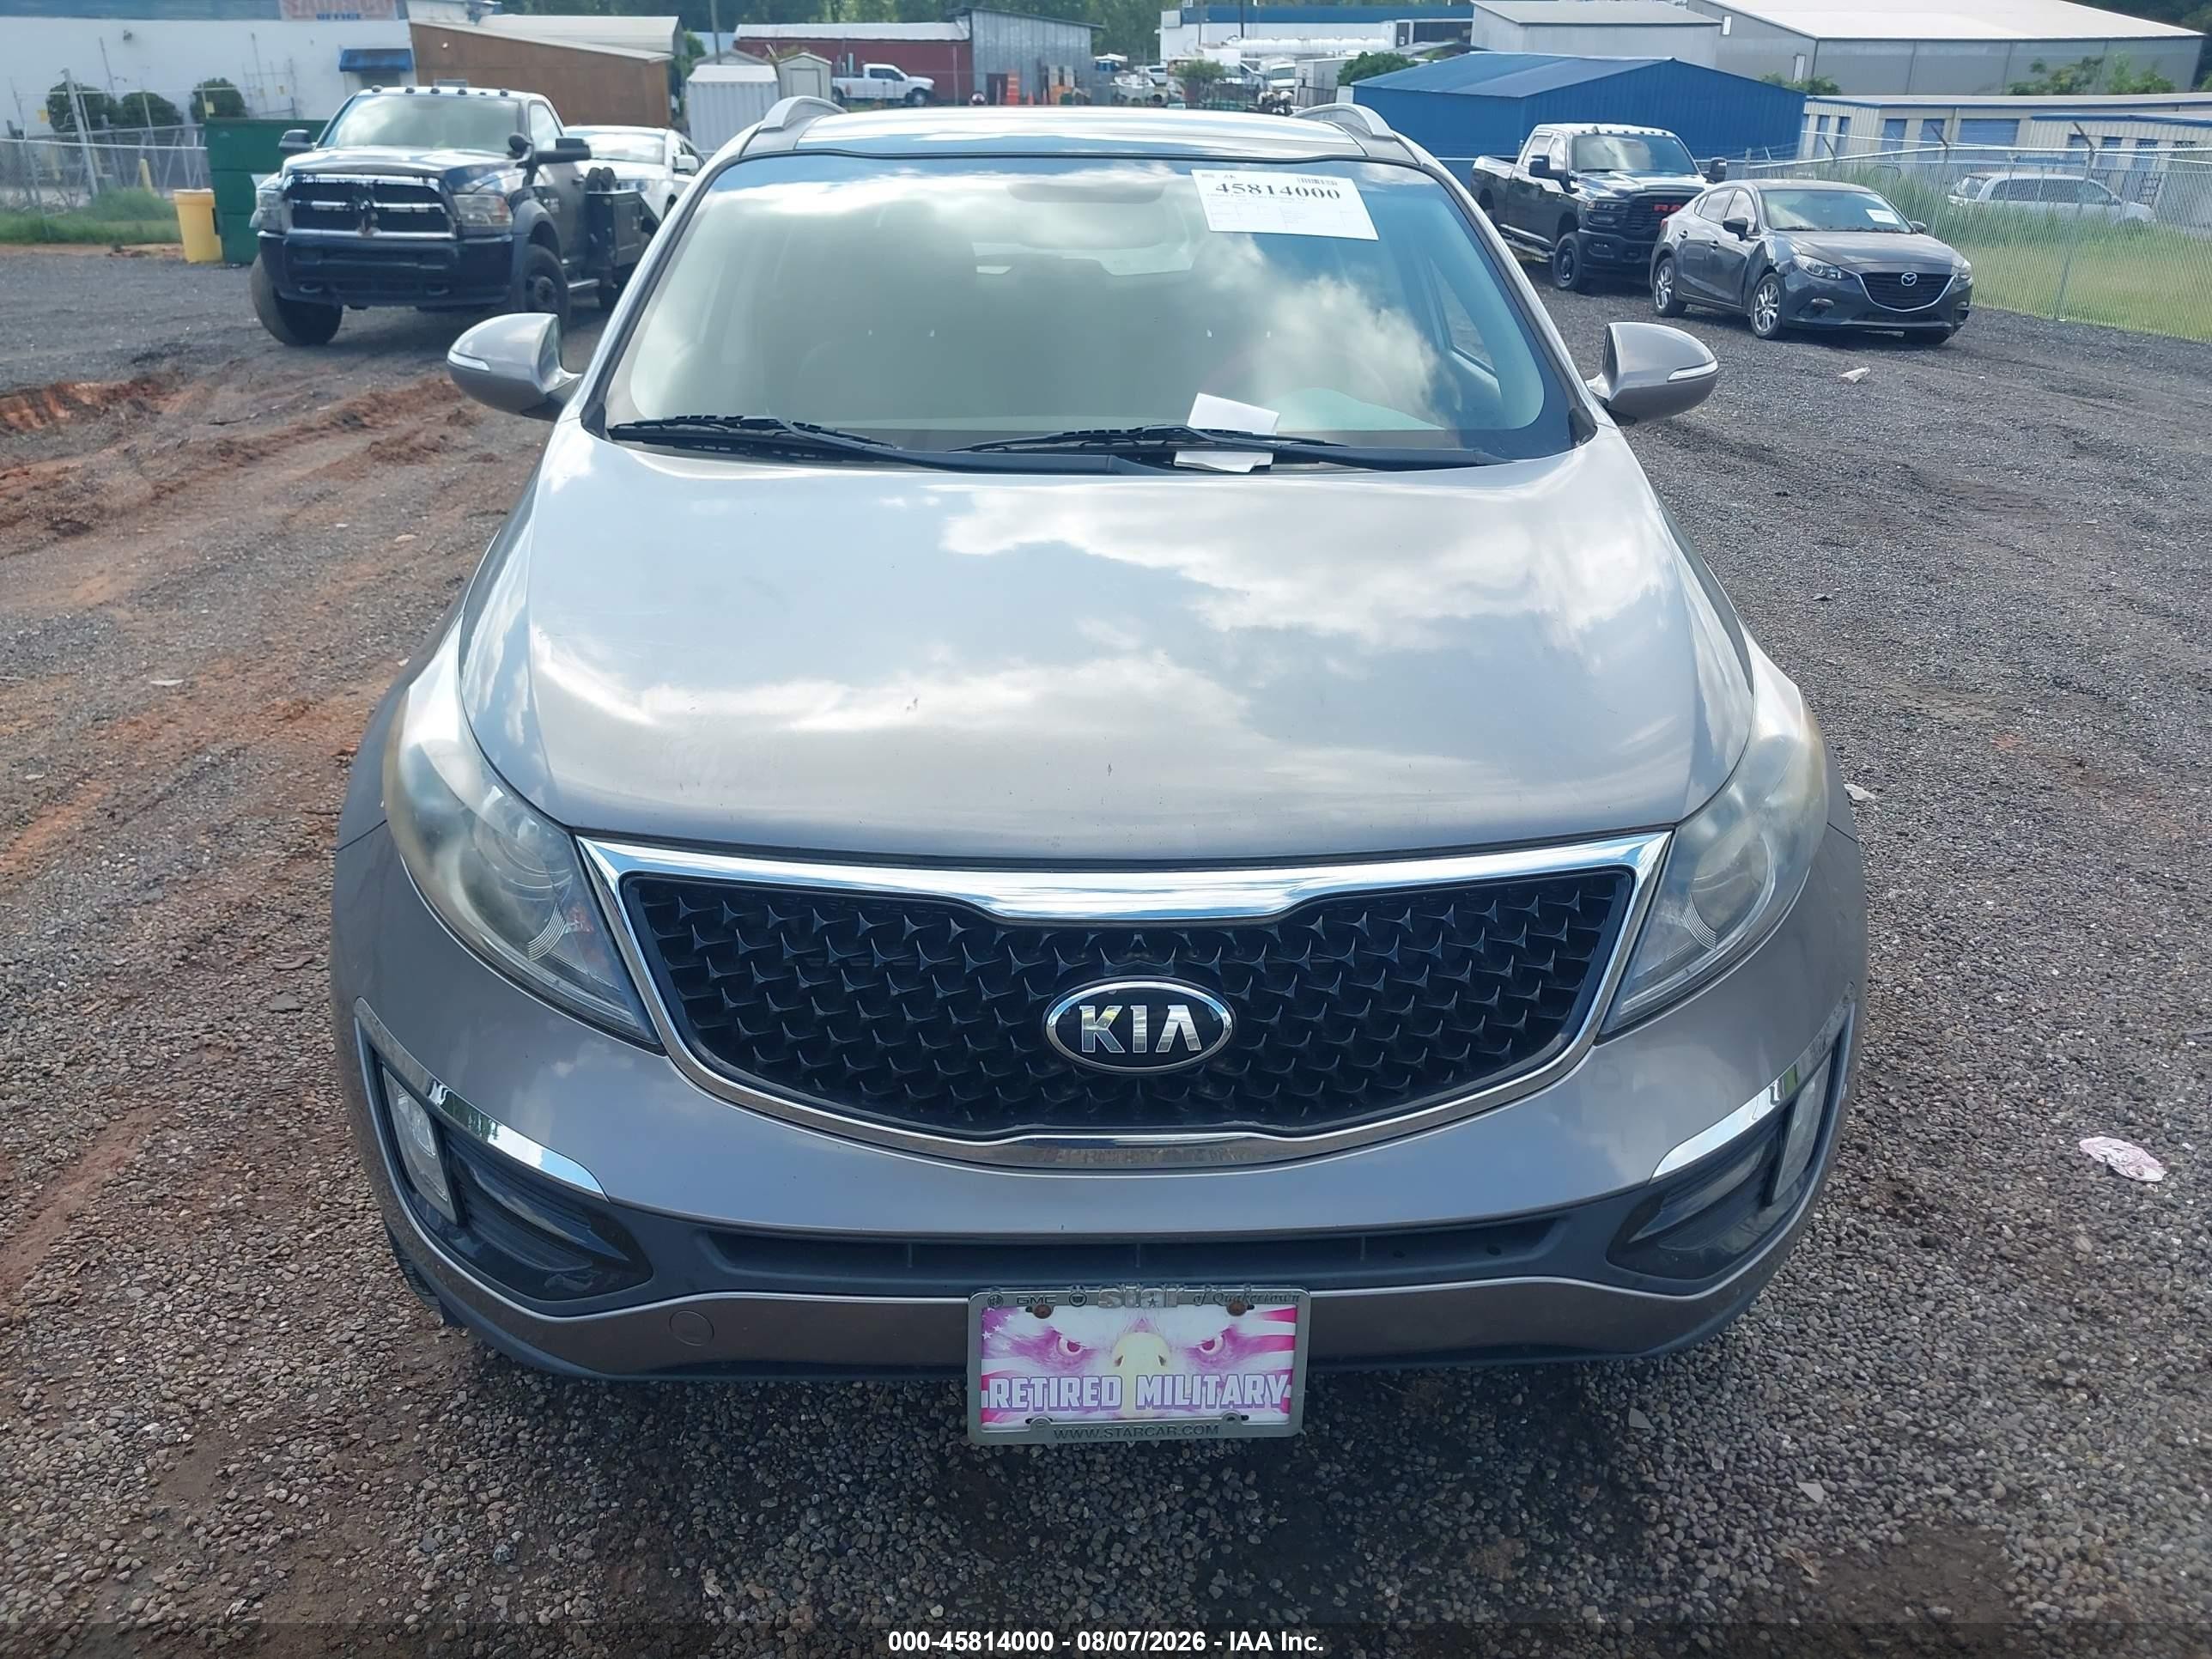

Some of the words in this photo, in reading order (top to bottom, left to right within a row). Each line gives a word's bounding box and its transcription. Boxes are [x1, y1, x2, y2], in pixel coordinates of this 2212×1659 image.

[1215, 182, 1340, 200] 45814000
[1079, 1005, 1202, 1054] KIA
[1017, 1295, 1056, 1305] GMC
[1193, 1293, 1206, 1306] of
[1212, 1292, 1300, 1306] Quakertown
[988, 1375, 1123, 1412] RETIRED
[1135, 1374, 1290, 1412] MILITARY
[1054, 1425, 1219, 1440] WWW.STARCAR.COM
